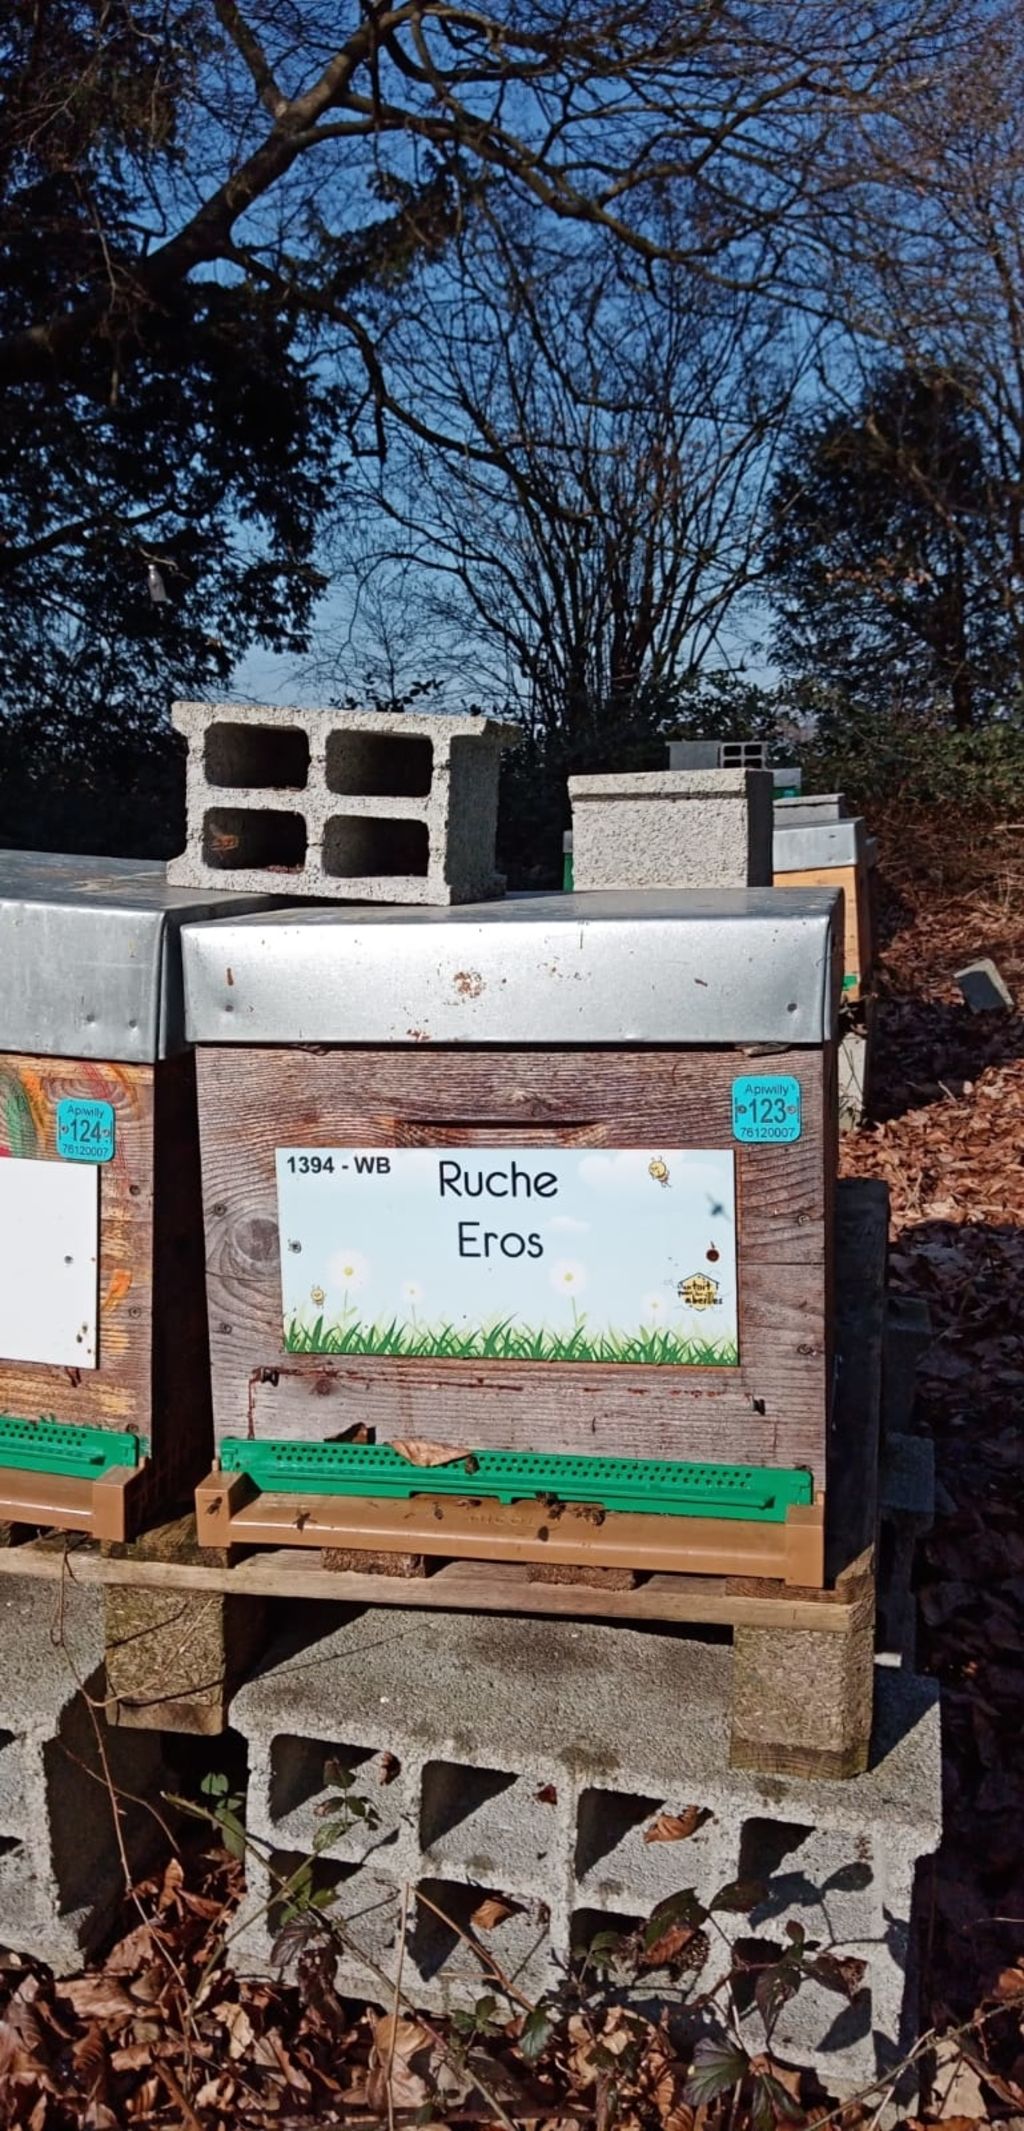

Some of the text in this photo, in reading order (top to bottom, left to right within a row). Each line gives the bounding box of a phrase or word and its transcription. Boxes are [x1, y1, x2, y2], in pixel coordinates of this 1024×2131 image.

[745, 1084, 789, 1097] Apiwilly
[748, 1098, 787, 1124] 123
[70, 1118, 102, 1143] 124
[740, 1127, 796, 1138] 76120007
[62, 1143, 109, 1157] 76120007
[286, 1156, 335, 1174] 1394
[354, 1157, 392, 1174] WB
[438, 1160, 559, 1198] Ruche
[458, 1221, 544, 1258] Eros
